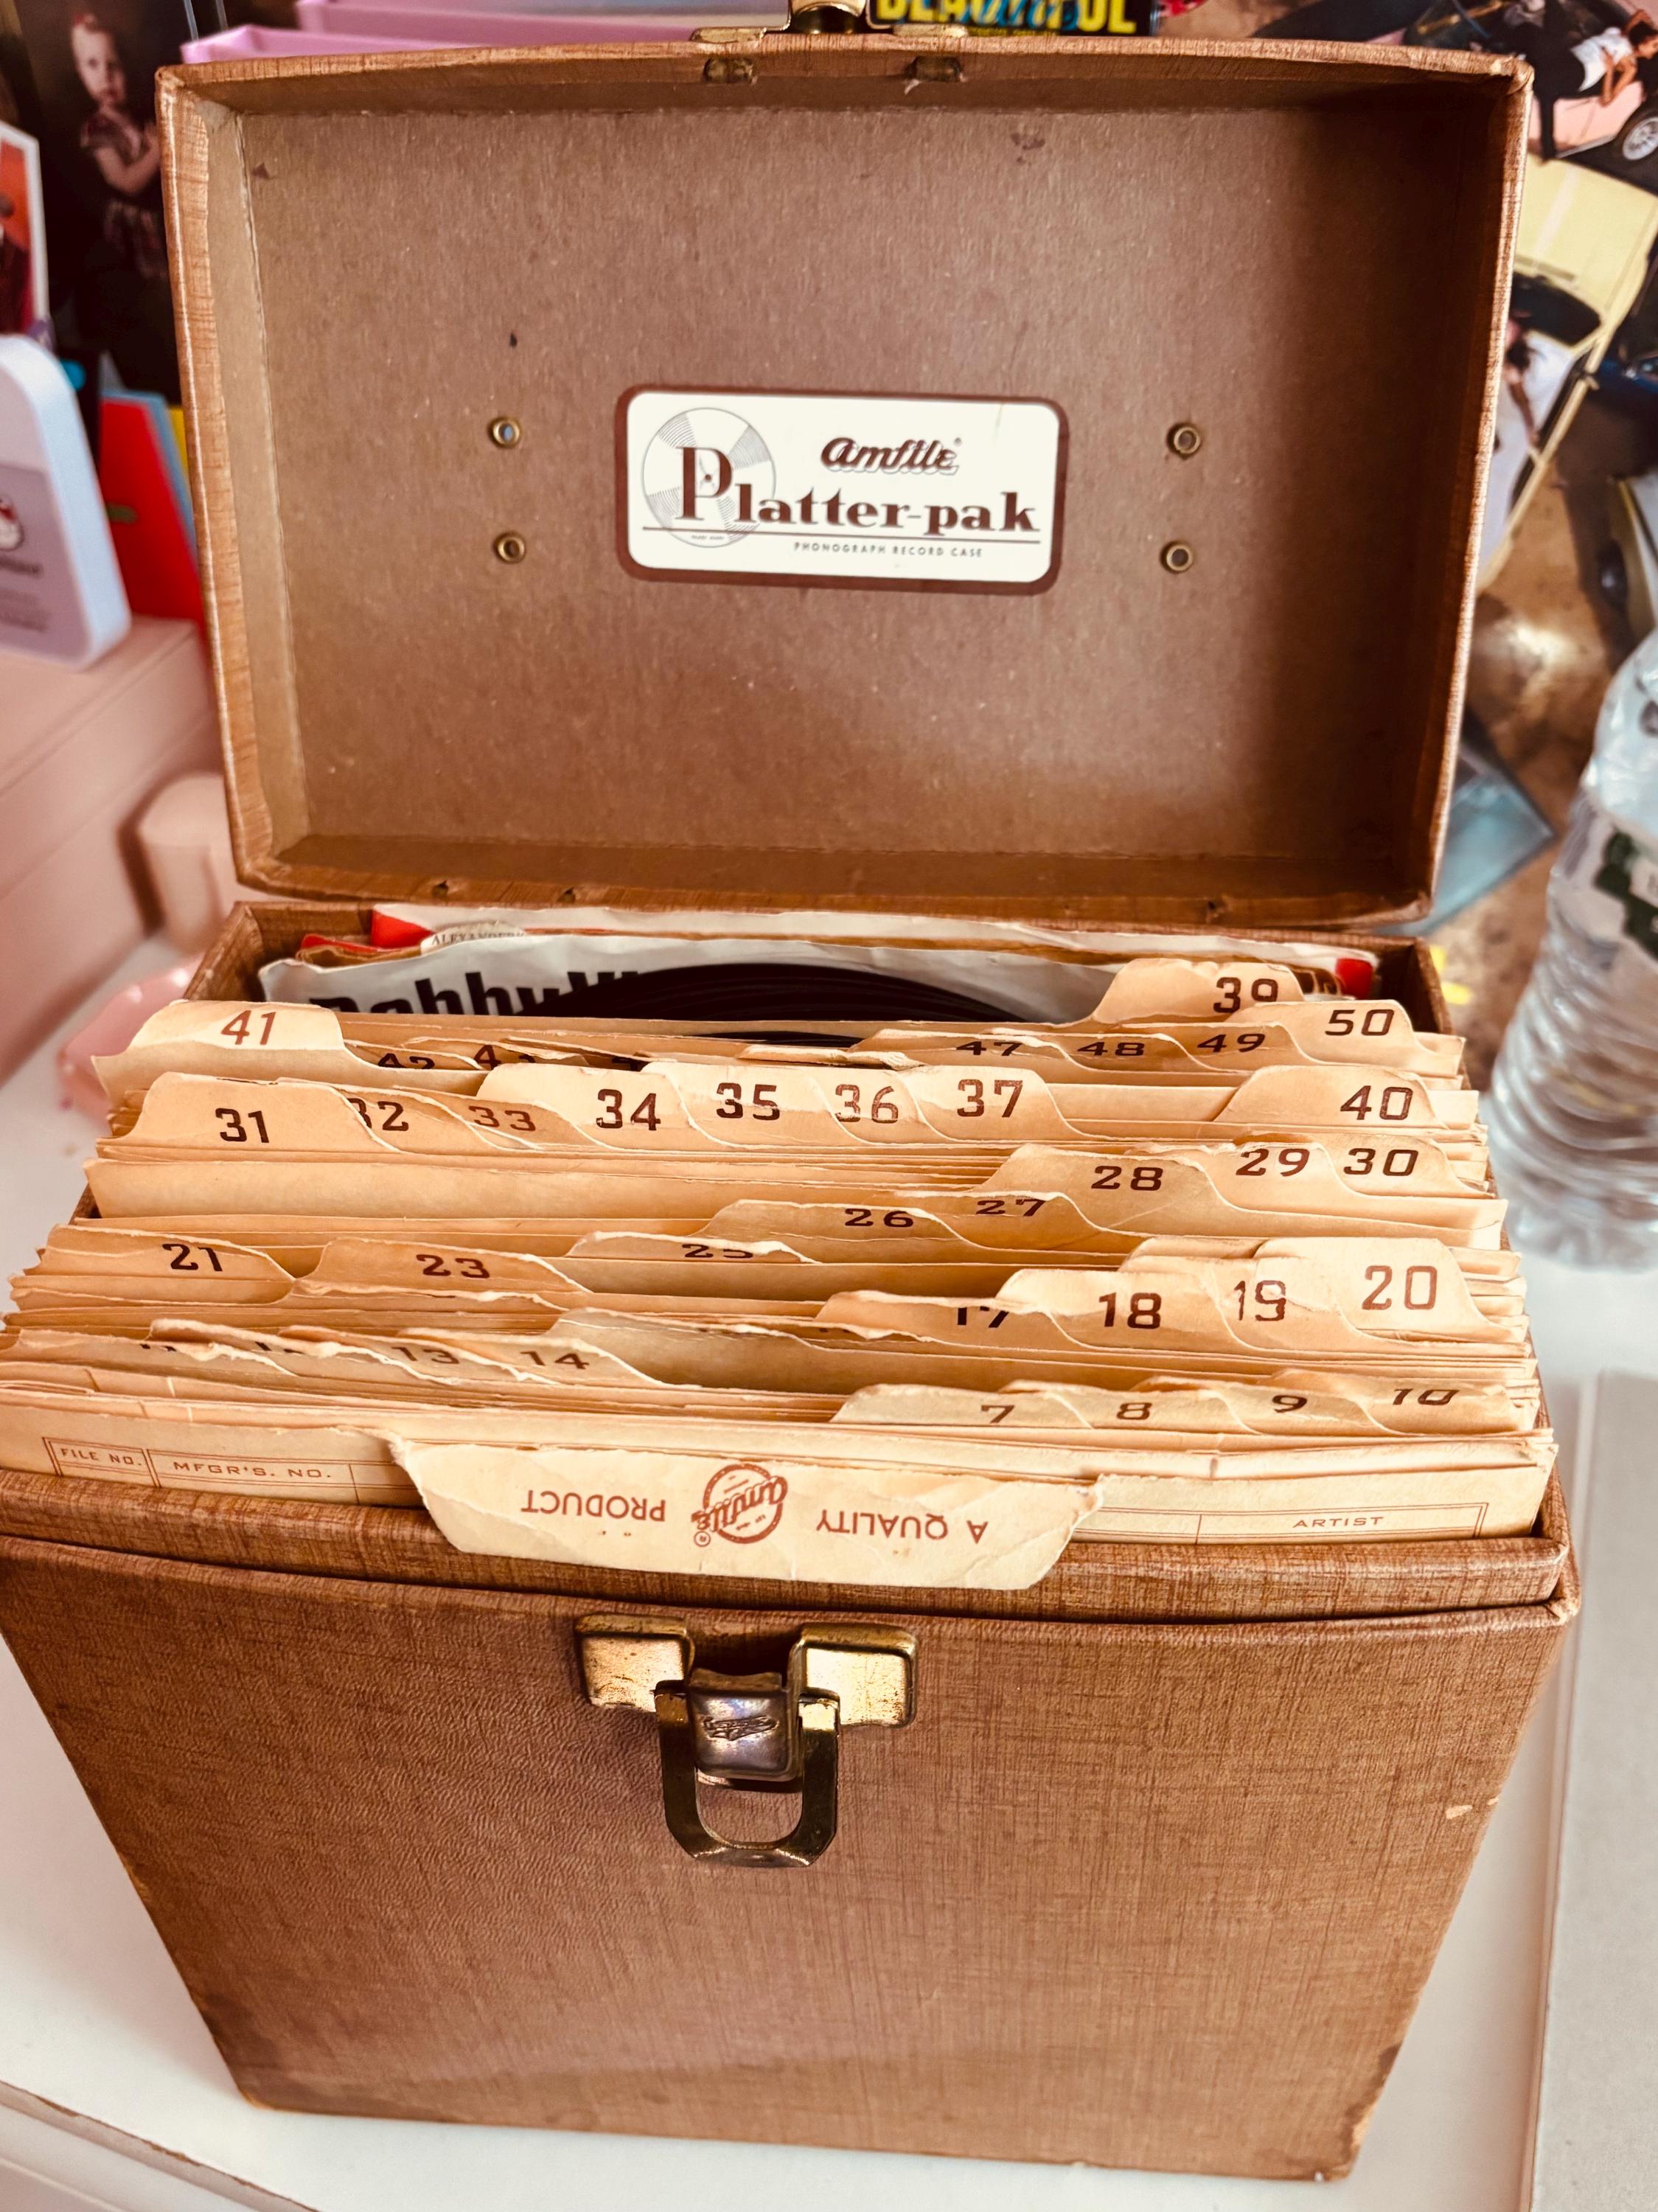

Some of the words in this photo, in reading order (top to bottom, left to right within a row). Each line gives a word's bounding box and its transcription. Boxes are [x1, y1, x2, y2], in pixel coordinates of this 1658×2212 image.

[675, 445, 1041, 537] Platter-pak
[794, 541, 885, 553] PHONOGRAPH
[893, 546, 944, 556] RECORD
[951, 547, 982, 557] CASE
[220, 1009, 276, 1046] 41
[1325, 1009, 1395, 1037] 50
[955, 1040, 1023, 1057] 47
[1076, 1041, 1145, 1057] 48
[1197, 1033, 1266, 1053] 49
[596, 1088, 661, 1131] 34
[716, 1082, 781, 1121] 35
[835, 1084, 899, 1124] 36
[956, 1079, 1023, 1119] 37
[1340, 1085, 1414, 1121] 40
[215, 1107, 270, 1144] 31
[468, 1105, 536, 1132] 33
[1235, 1148, 1310, 1177] 29
[1343, 1147, 1419, 1177] 30
[1090, 1165, 1163, 1192] 28
[844, 1208, 914, 1228] 26
[975, 1198, 1046, 1217] 27
[161, 1243, 223, 1272] 21
[416, 1253, 490, 1279] 23
[1233, 1280, 1287, 1322] 19
[1362, 1265, 1438, 1311] 20
[1098, 1293, 1162, 1330] 18
[391, 1346, 460, 1365] 13
[520, 1351, 590, 1370] 14
[1272, 1394, 1308, 1413] 9
[1393, 1388, 1460, 1406] 10
[980, 1405, 1015, 1424] 7
[1116, 1402, 1153, 1421] 8
[60, 1447, 99, 1461] FILE
[108, 1453, 142, 1466] NO.
[288, 1468, 331, 1478] NO.
[520, 1489, 666, 1522] PRODUCT
[816, 1509, 948, 1540] QUALITY
[966, 1520, 989, 1544] A
[1292, 1516, 1384, 1528] ARTIST
